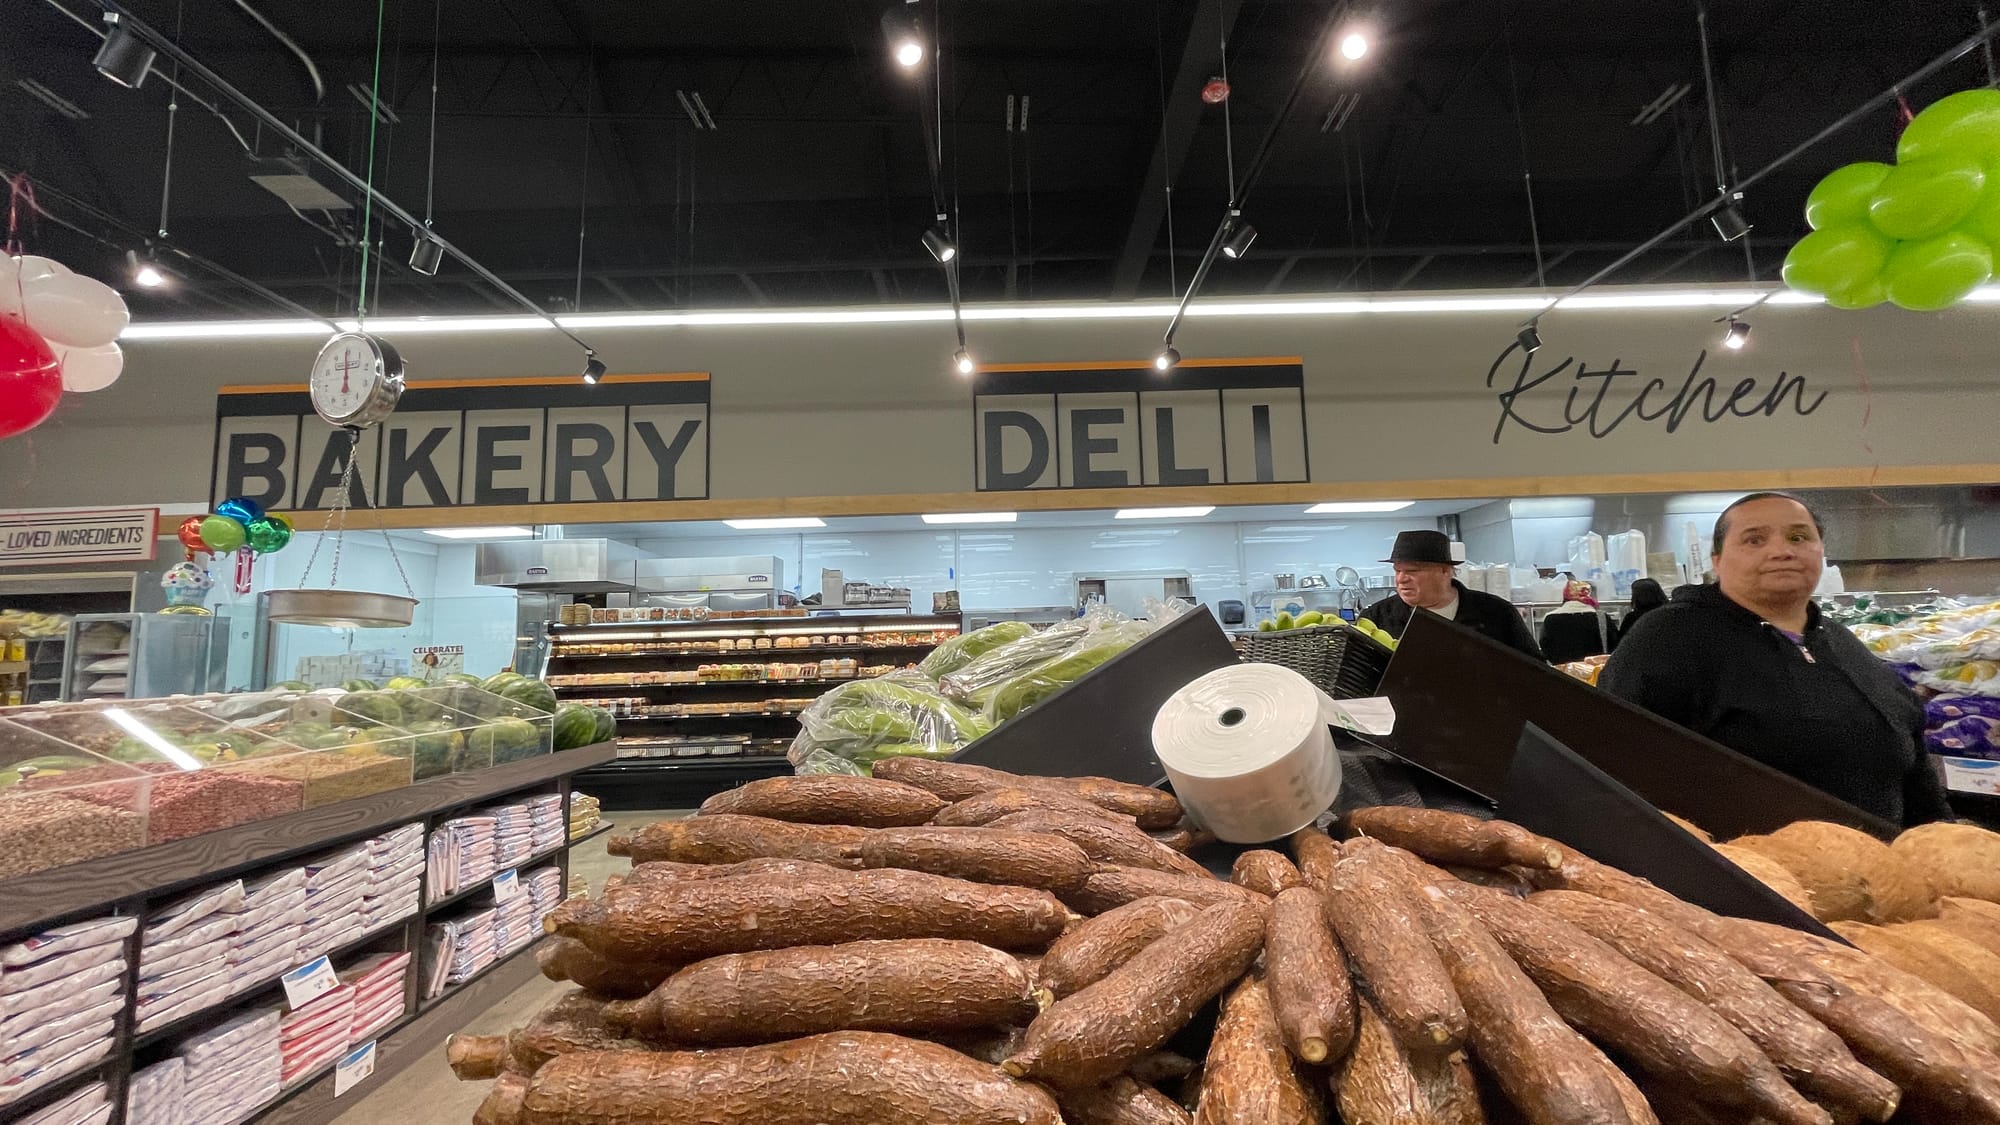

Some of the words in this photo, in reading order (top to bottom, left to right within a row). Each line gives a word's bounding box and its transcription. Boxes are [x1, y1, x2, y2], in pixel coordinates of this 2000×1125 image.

[1487, 341, 1829, 444] Kitchen
[225, 420, 701, 510] BAKERY
[984, 405, 1274, 489] DELI
[54, 527, 144, 547] INGREDIENTS
[413, 645, 463, 654] CELEBRATE!
